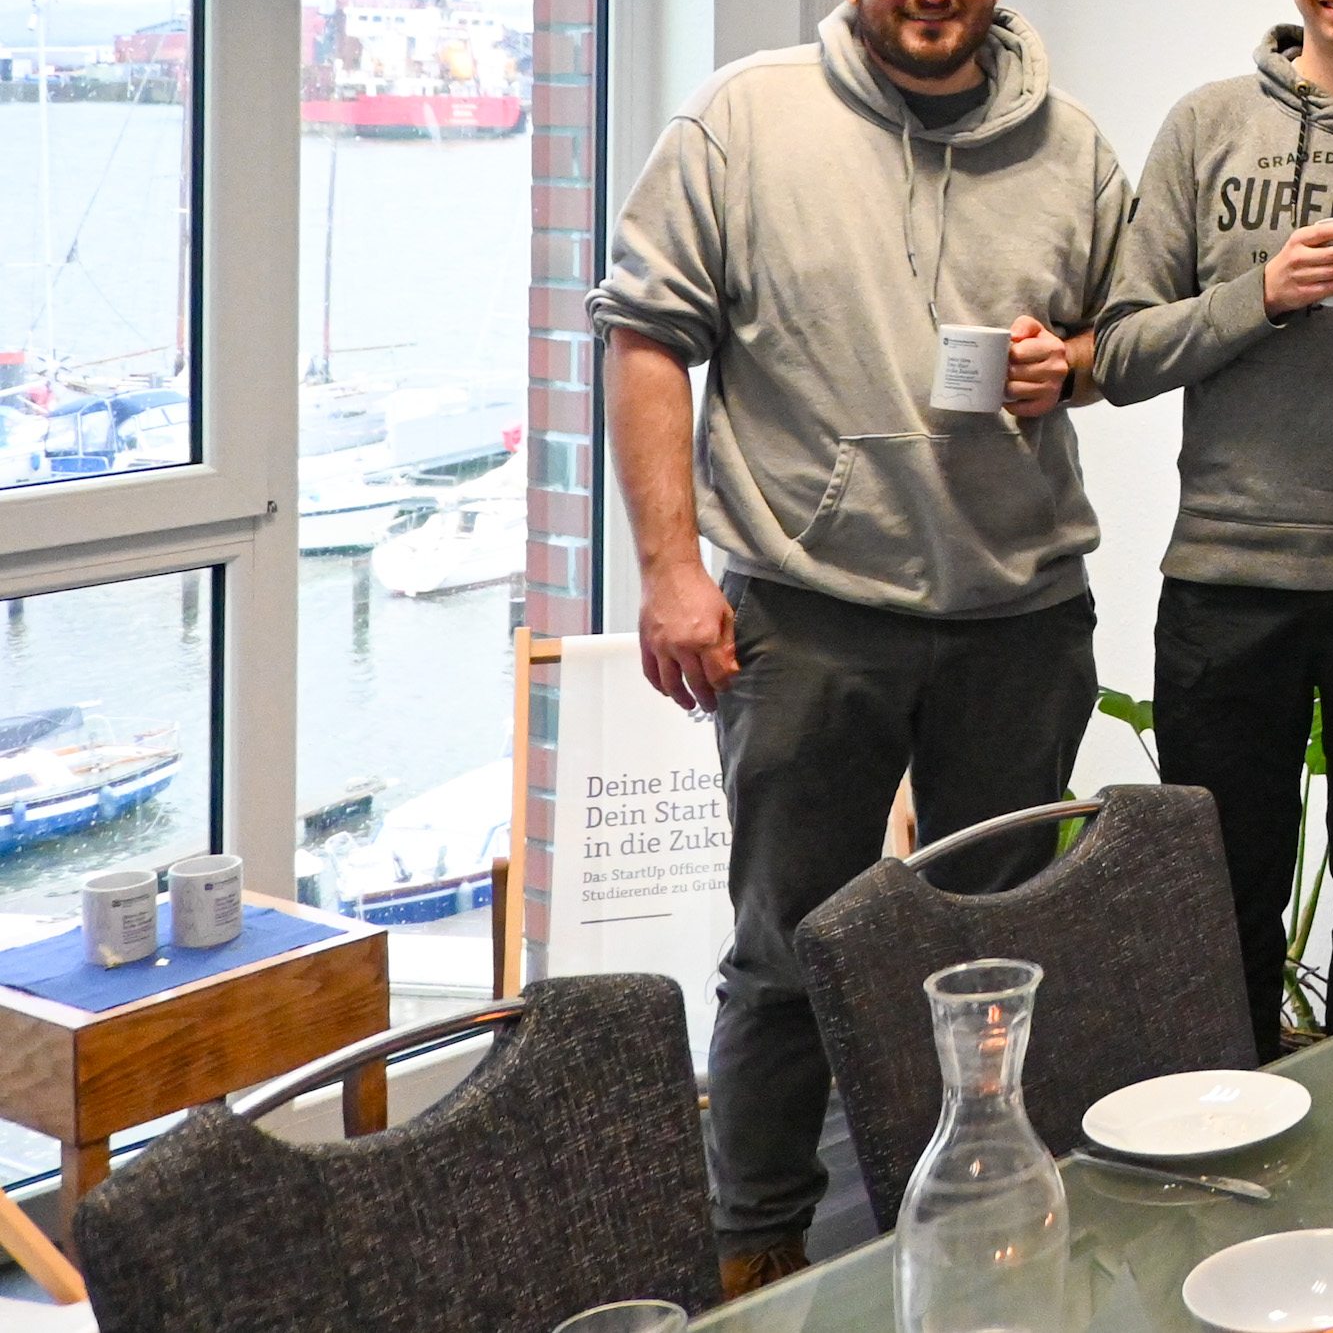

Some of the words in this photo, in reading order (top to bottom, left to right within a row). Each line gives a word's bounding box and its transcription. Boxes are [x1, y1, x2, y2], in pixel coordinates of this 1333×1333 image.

[586, 773, 662, 798] Deine
[585, 803, 647, 829] Dein
[655, 798, 721, 823] Start
[583, 836, 611, 859] in
[620, 832, 661, 856] die
[669, 826, 733, 852] Zuku
[582, 871, 608, 884] Das
[611, 865, 666, 881] StartUp
[669, 862, 711, 876] Office
[581, 882, 668, 902] Studierende
[671, 882, 689, 894] zu
[692, 877, 730, 892] Grün
